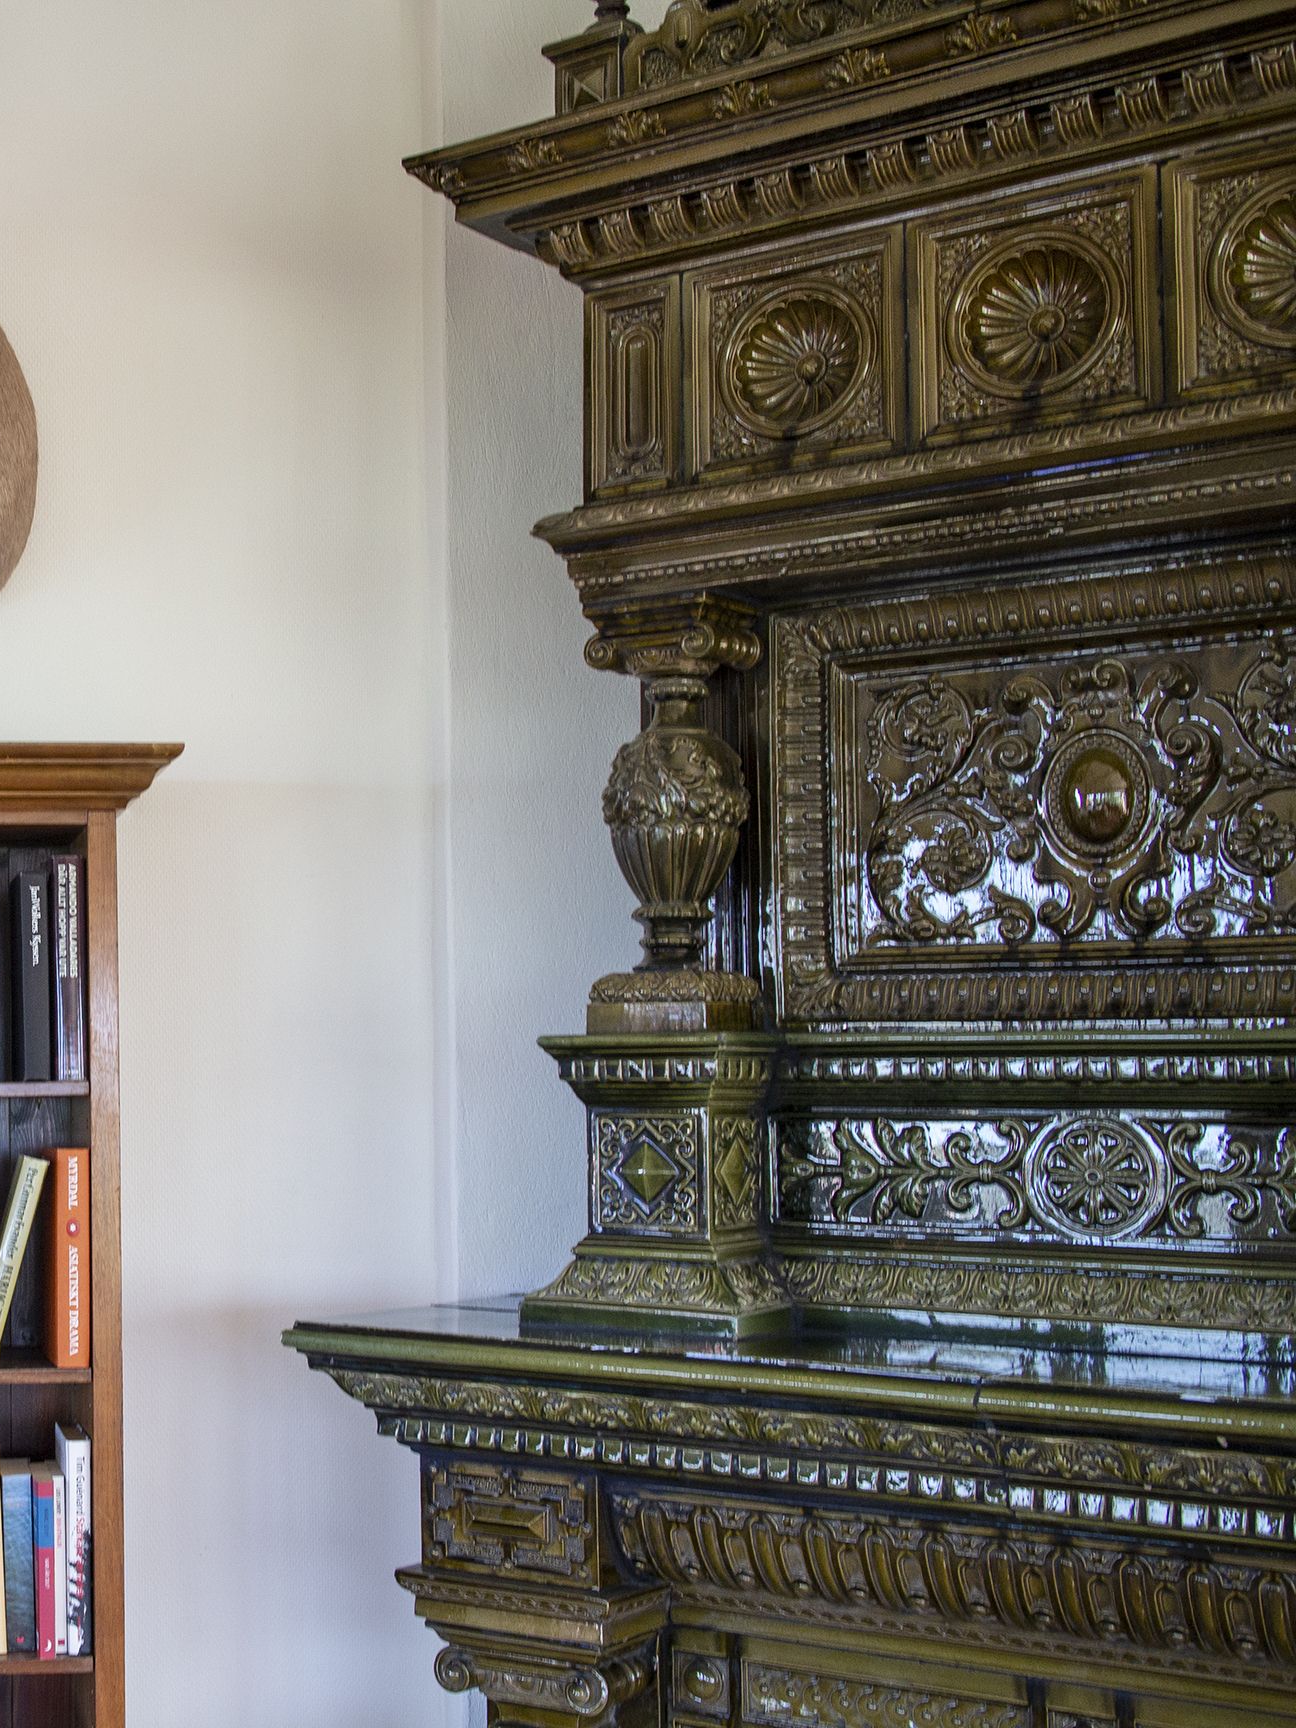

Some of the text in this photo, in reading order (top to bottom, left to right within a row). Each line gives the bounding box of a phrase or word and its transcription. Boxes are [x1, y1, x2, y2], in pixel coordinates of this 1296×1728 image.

[58, 864, 68, 886] DÄR
[58, 908, 67, 936] HOPP
[68, 864, 78, 978] ARMANDO VALLADARES
[59, 958, 67, 978] UTE
[68, 1156, 78, 1210] MYRDAL
[68, 1244, 79, 1356] ASIATISKT DRAMA
[76, 1457, 85, 1473] Tim
